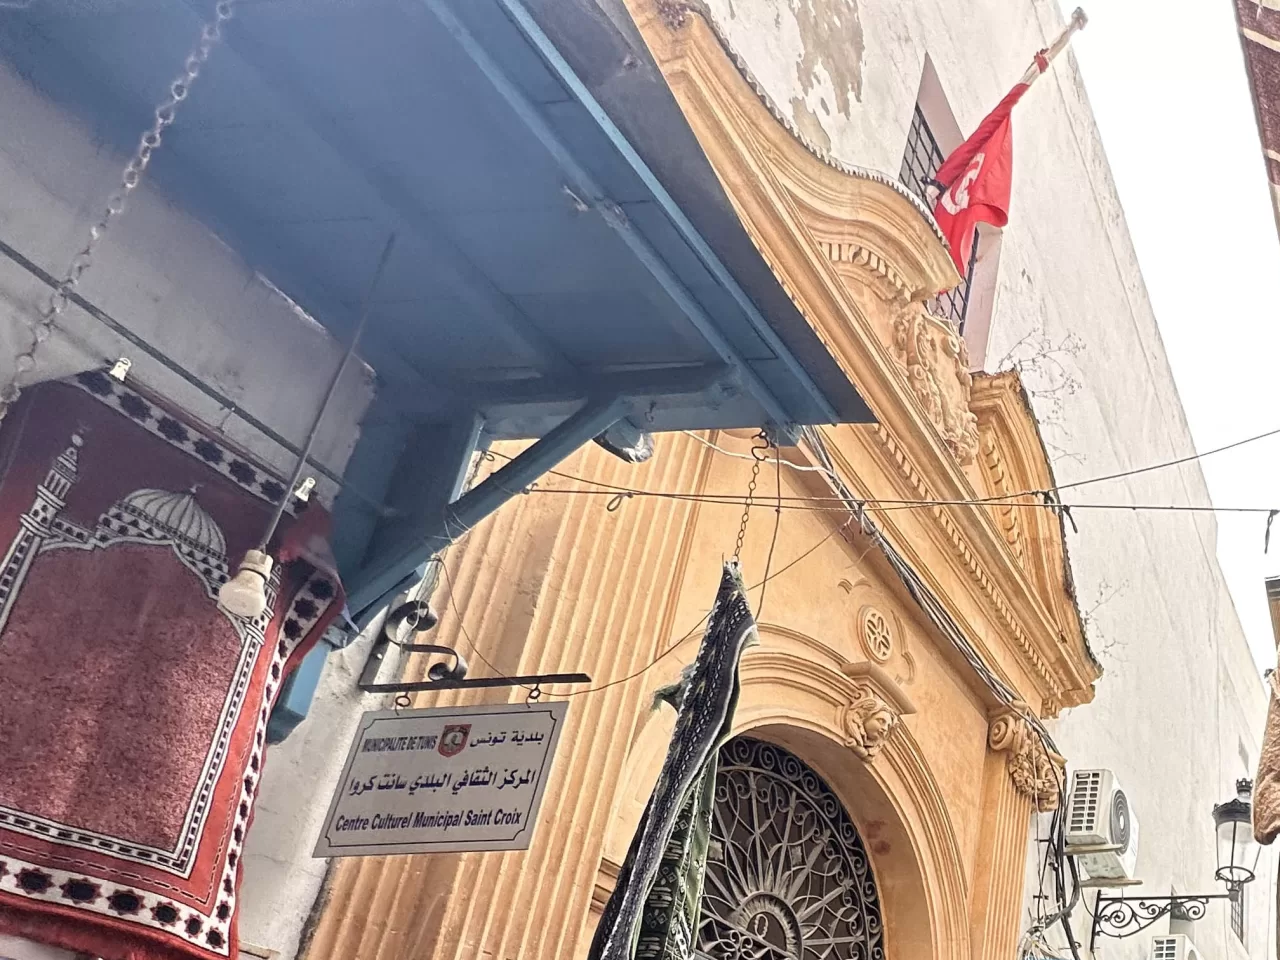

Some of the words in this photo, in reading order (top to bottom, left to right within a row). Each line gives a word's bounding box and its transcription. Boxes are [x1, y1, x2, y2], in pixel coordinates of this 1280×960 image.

[406, 736, 418, 751] DE
[416, 735, 438, 750] TUNIS
[470, 731, 507, 747] تونس
[349, 775, 378, 796] كروا
[408, 773, 453, 796] البلدي
[452, 765, 498, 795] الثقافي
[497, 768, 537, 790] المركز
[335, 814, 370, 832] Centre
[371, 812, 414, 831] Culturel
[412, 811, 464, 832] Municipal
[464, 808, 493, 826] Saint
[493, 807, 522, 826] Croix
